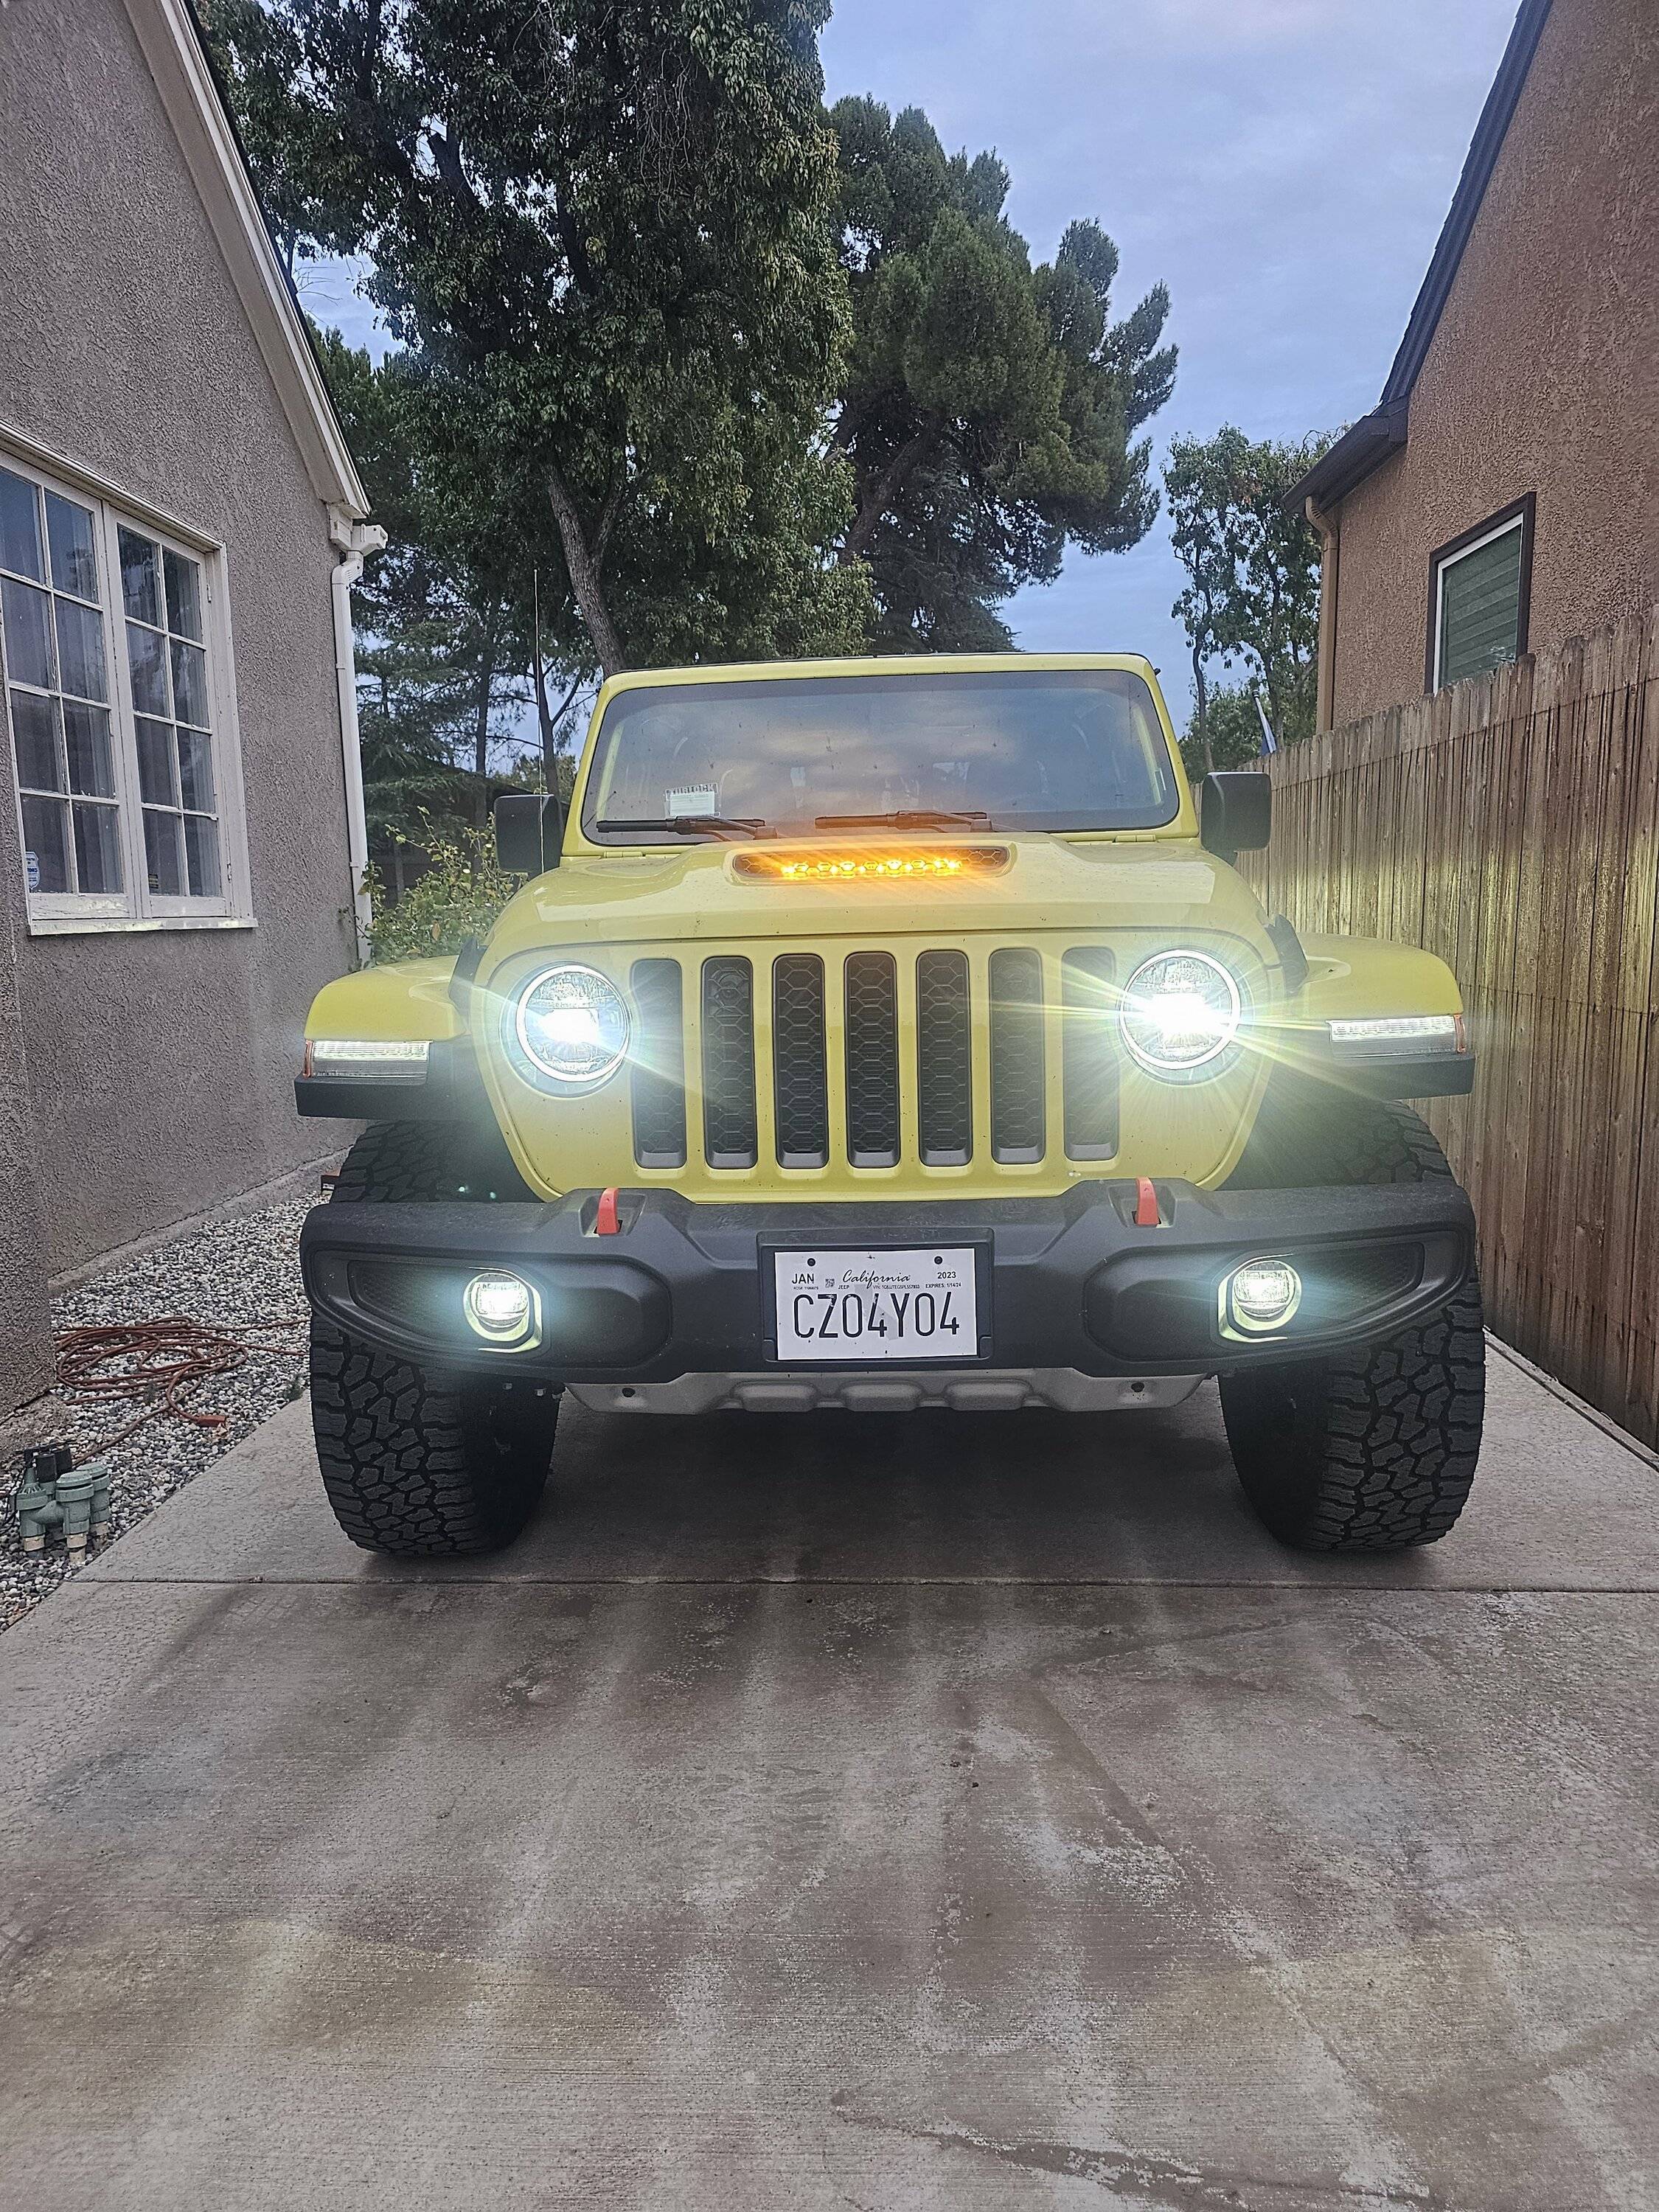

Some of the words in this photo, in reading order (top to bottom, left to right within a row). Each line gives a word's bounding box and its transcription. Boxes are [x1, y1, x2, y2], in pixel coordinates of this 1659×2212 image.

[792, 1273, 814, 1284] JAN
[843, 1270, 910, 1289] California
[937, 1271, 956, 1279] 2023
[793, 1292, 960, 1338] CZ04Y04
